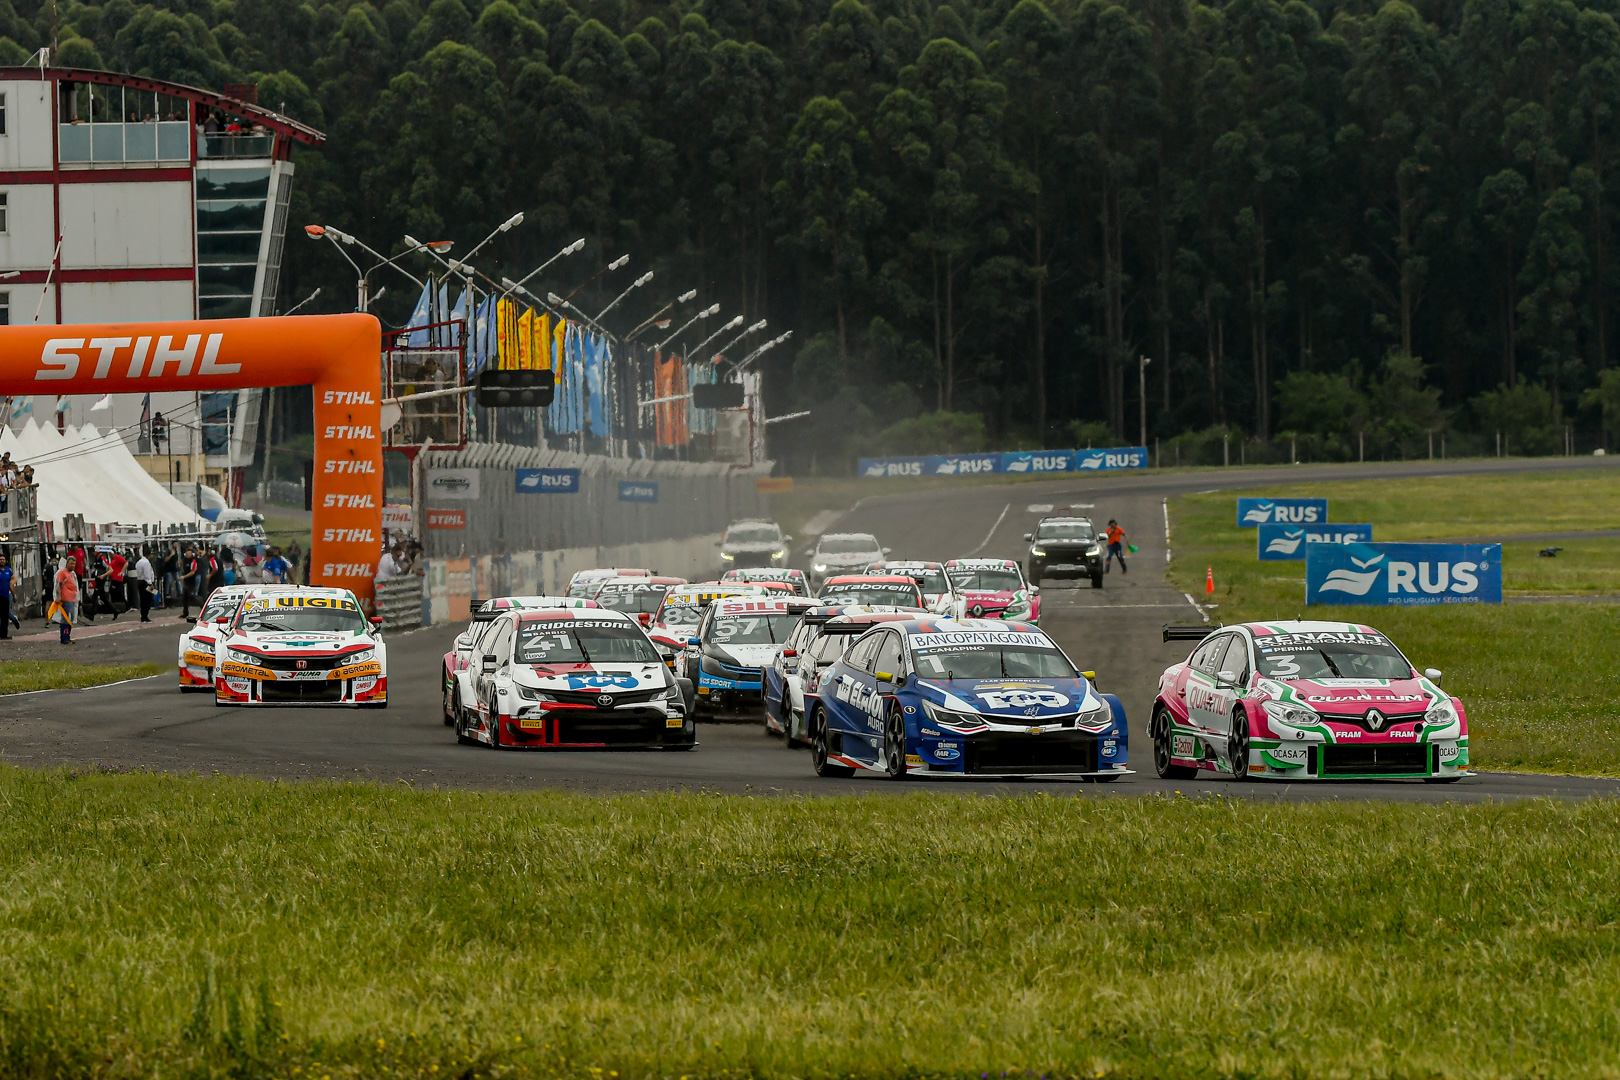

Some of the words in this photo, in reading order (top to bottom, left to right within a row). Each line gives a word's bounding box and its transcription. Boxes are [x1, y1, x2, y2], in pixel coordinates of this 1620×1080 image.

[34, 332, 242, 381] STIHL
[323, 390, 375, 405] STIHL
[324, 425, 376, 440] STIHL
[324, 459, 376, 474] STIHL
[959, 459, 993, 473] RUS
[1032, 456, 1068, 470] RUS
[1104, 453, 1141, 468] RUS
[888, 462, 921, 476] RUS
[541, 475, 572, 486] RUS
[323, 494, 376, 509] STIHL
[429, 515, 464, 525] STIHL
[1274, 506, 1318, 522] RUS
[322, 528, 375, 543] STIHL
[322, 563, 373, 577] STIHL
[1387, 561, 1479, 594] RUS
[827, 583, 912, 592] Taraborelli
[241, 613, 260, 631] 5
[663, 608, 701, 625] 83
[523, 621, 632, 631] BRIDGESTONE
[715, 619, 759, 637] 57
[523, 635, 572, 650] 41
[1254, 633, 1384, 646] RENAULT
[1258, 639, 1390, 648] CONCESIONARIOS
[920, 655, 945, 673] 1
[1265, 655, 1301, 676] 3
[711, 679, 732, 687] SPORT
[1308, 694, 1423, 702] QUANTIUM
[1273, 750, 1298, 758] OCASA
[1439, 748, 1457, 757] OCASA
